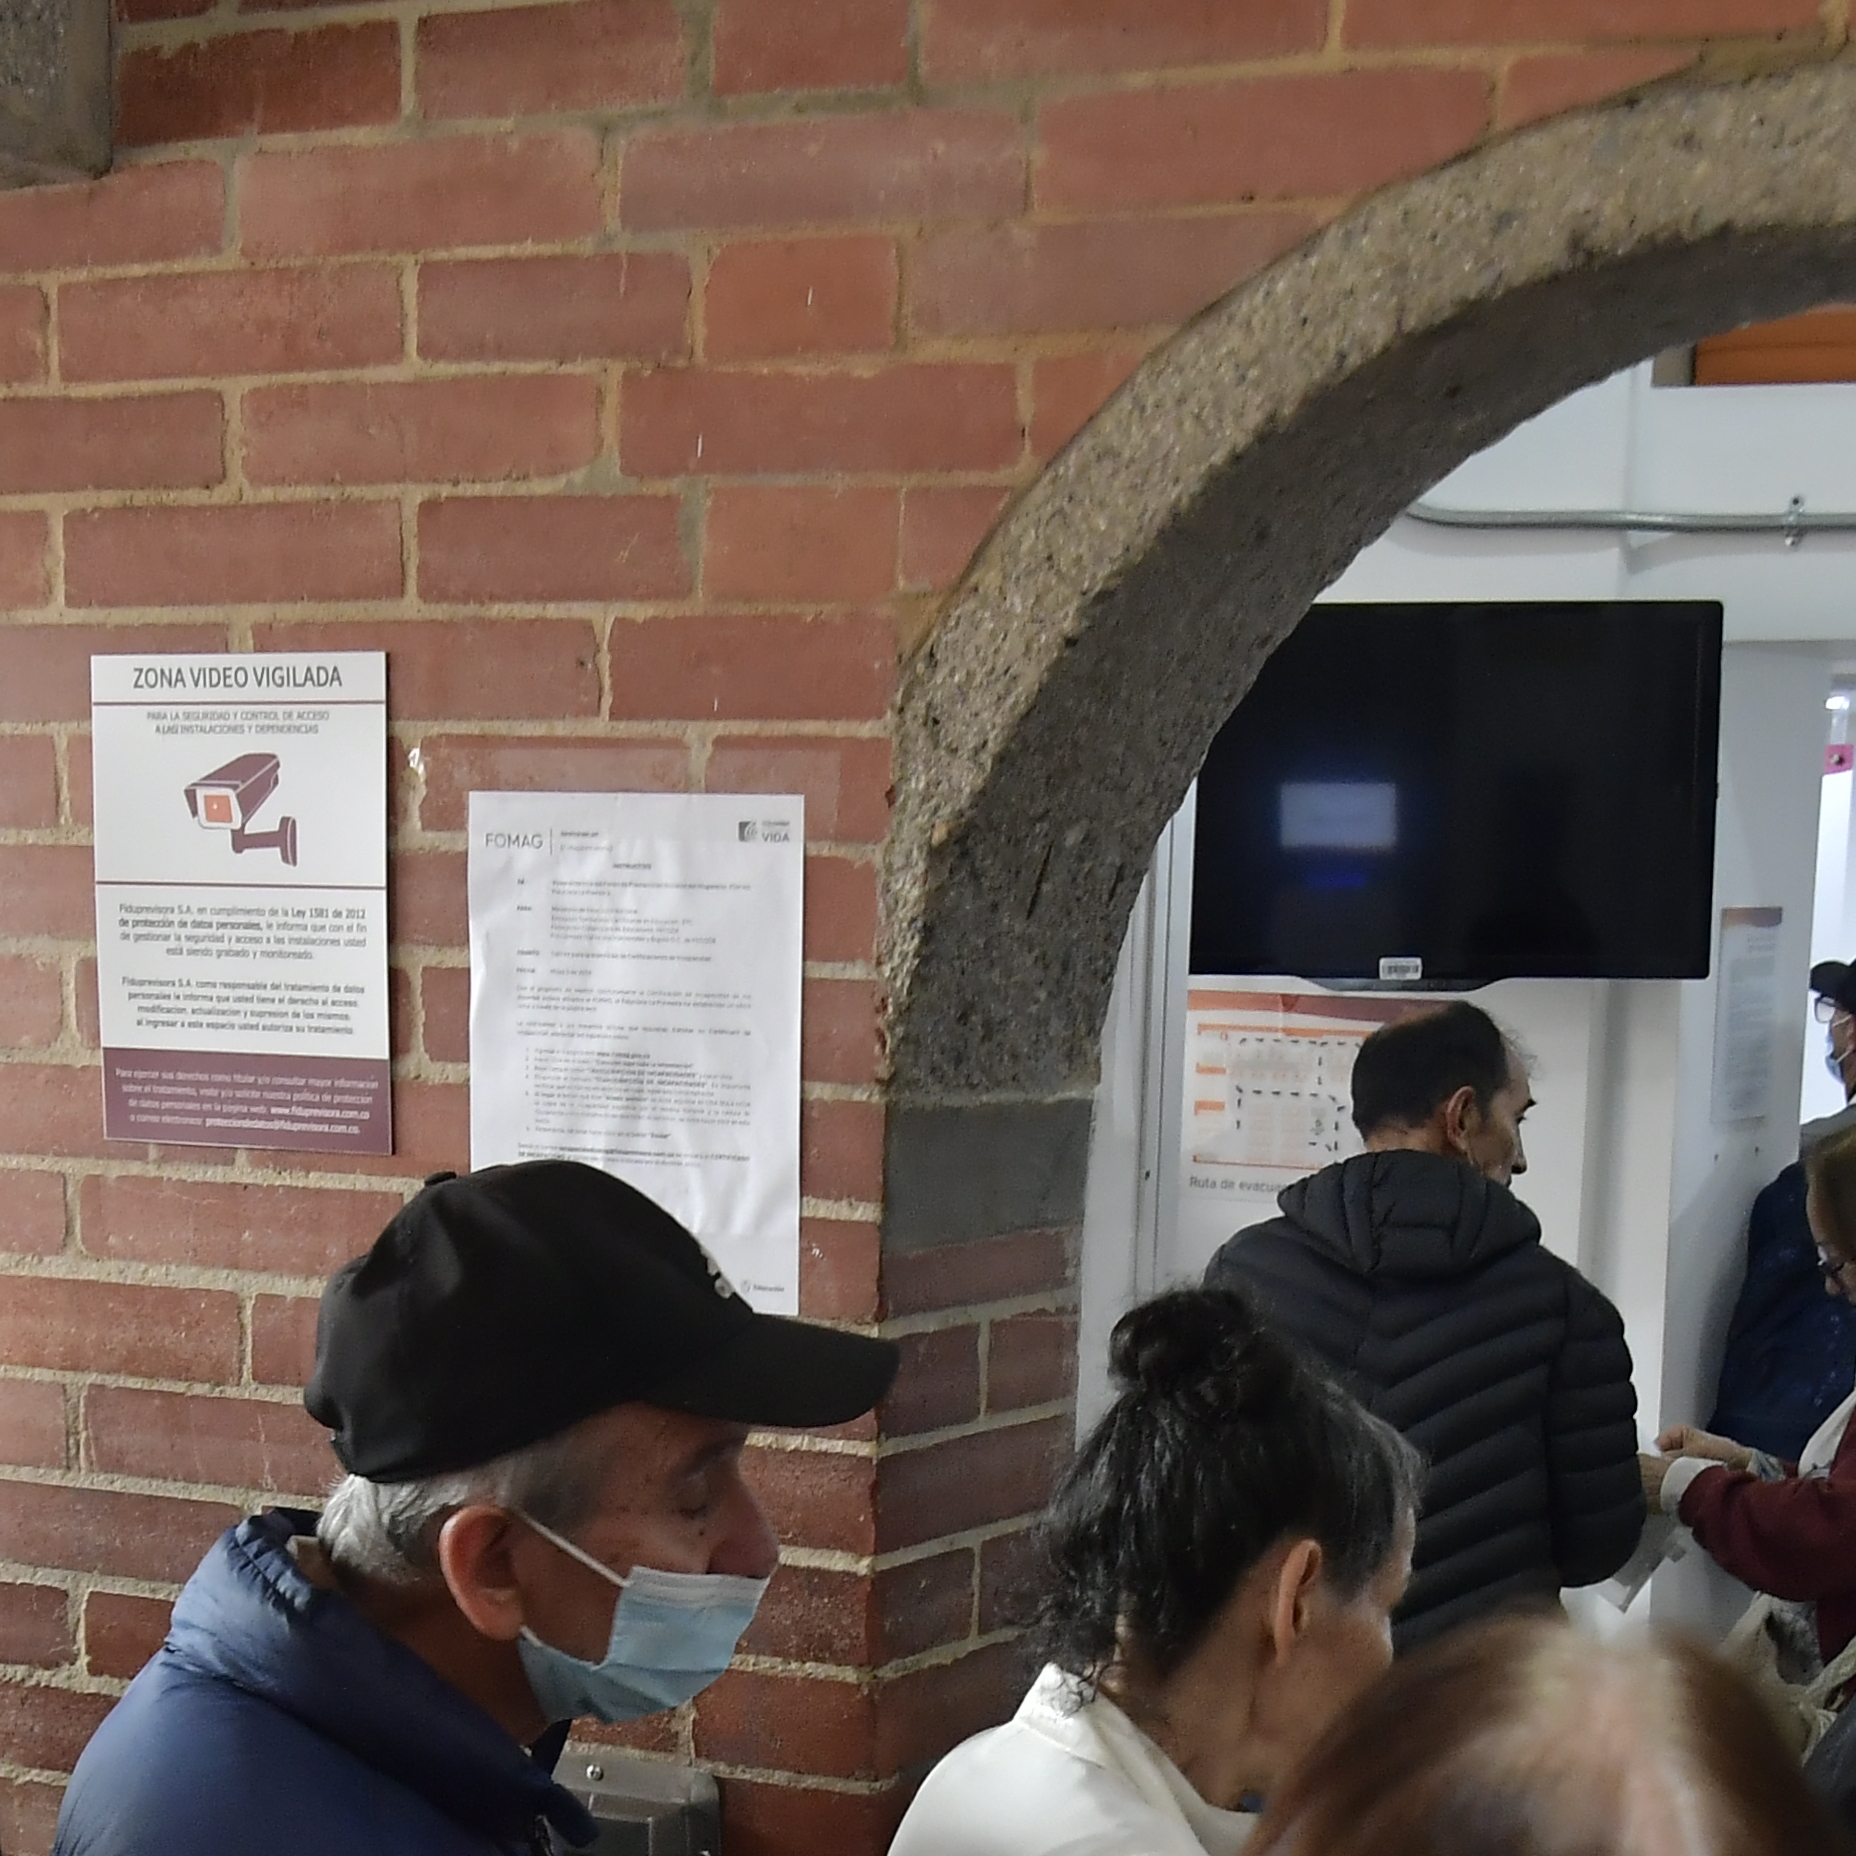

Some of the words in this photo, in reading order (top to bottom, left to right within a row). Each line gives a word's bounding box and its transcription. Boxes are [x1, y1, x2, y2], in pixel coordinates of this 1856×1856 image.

[133, 667, 187, 689] ZONA
[189, 666, 249, 688] VIDEO
[252, 665, 343, 688] VIGILADA
[146, 711, 168, 721] PARA
[170, 711, 180, 721] LA
[182, 711, 230, 721] SEGURIDAD
[233, 711, 239, 721] Y
[240, 711, 280, 721] CONTROL
[282, 711, 294, 721] DE
[296, 711, 330, 721] ACCESO
[155, 724, 161, 734] A
[180, 724, 245, 735] INSTALACIONES
[248, 724, 253, 734] Y
[255, 724, 319, 735] DEPENDENCIAS
[485, 832, 544, 849] FOMAG
[761, 832, 790, 843] VIDA
[196, 906, 208, 915] en
[209, 905, 267, 918] cumplimiento
[268, 907, 279, 917] de
[280, 907, 289, 918] la
[291, 907, 307, 919] Ley
[309, 907, 329, 919] 1581
[331, 908, 343, 919] de
[345, 908, 366, 919] 2012
[118, 918, 129, 928] de
[131, 916, 175, 929] protección
[177, 918, 188, 929] de
[190, 919, 213, 929] datos
[265, 920, 274, 930] le
[276, 920, 308, 931] informa
[310, 922, 327, 933] que
[328, 923, 344, 932] con
[346, 922, 354, 932] el
[356, 922, 367, 933] fin
[120, 931, 131, 941] de
[132, 932, 172, 943] gestionar
[174, 932, 182, 942] la
[184, 933, 225, 944] seguridad
[227, 936, 233, 946] y
[235, 935, 264, 945] acceso
[265, 936, 271, 944] a
[273, 935, 286, 945] las
[288, 935, 341, 946] instalaciones
[343, 937, 367, 947] usted
[165, 946, 184, 956] está
[186, 947, 214, 957] siendo
[215, 948, 250, 959] grabado
[252, 950, 257, 960] y
[195, 980, 217, 988] como
[284, 982, 330, 993] tratamiento
[232, 995, 255, 1004] usted
[1188, 1174, 1217, 1190] Ruta
[1220, 1178, 1235, 1190] de
